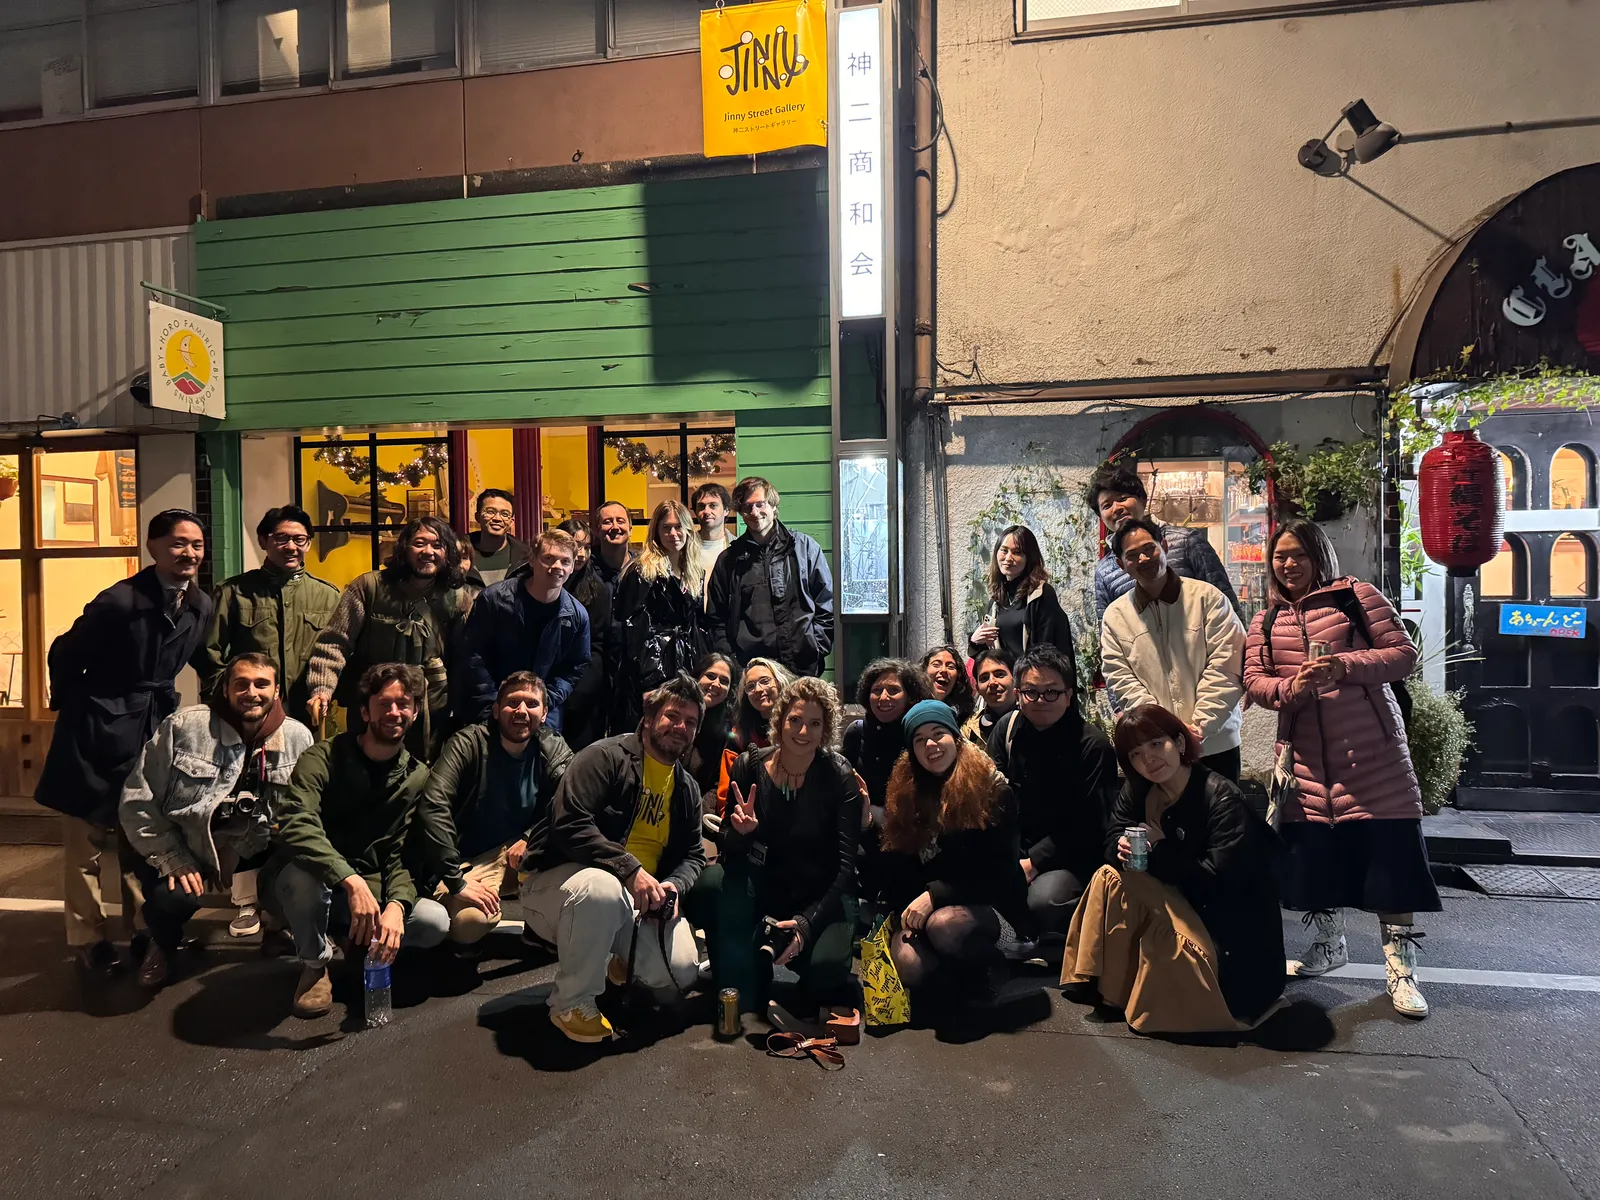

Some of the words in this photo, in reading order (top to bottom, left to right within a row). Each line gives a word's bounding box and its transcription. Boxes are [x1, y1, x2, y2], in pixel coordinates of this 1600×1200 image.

[724, 112, 746, 122] Jinny
[748, 107, 773, 119] Street
[775, 103, 806, 114] Gallery
[847, 51, 874, 276] 神二商和会
[159, 320, 180, 344] HORO
[184, 320, 216, 357] FAMIRIC
[158, 354, 171, 386] BABY
[212, 367, 219, 380] BY
